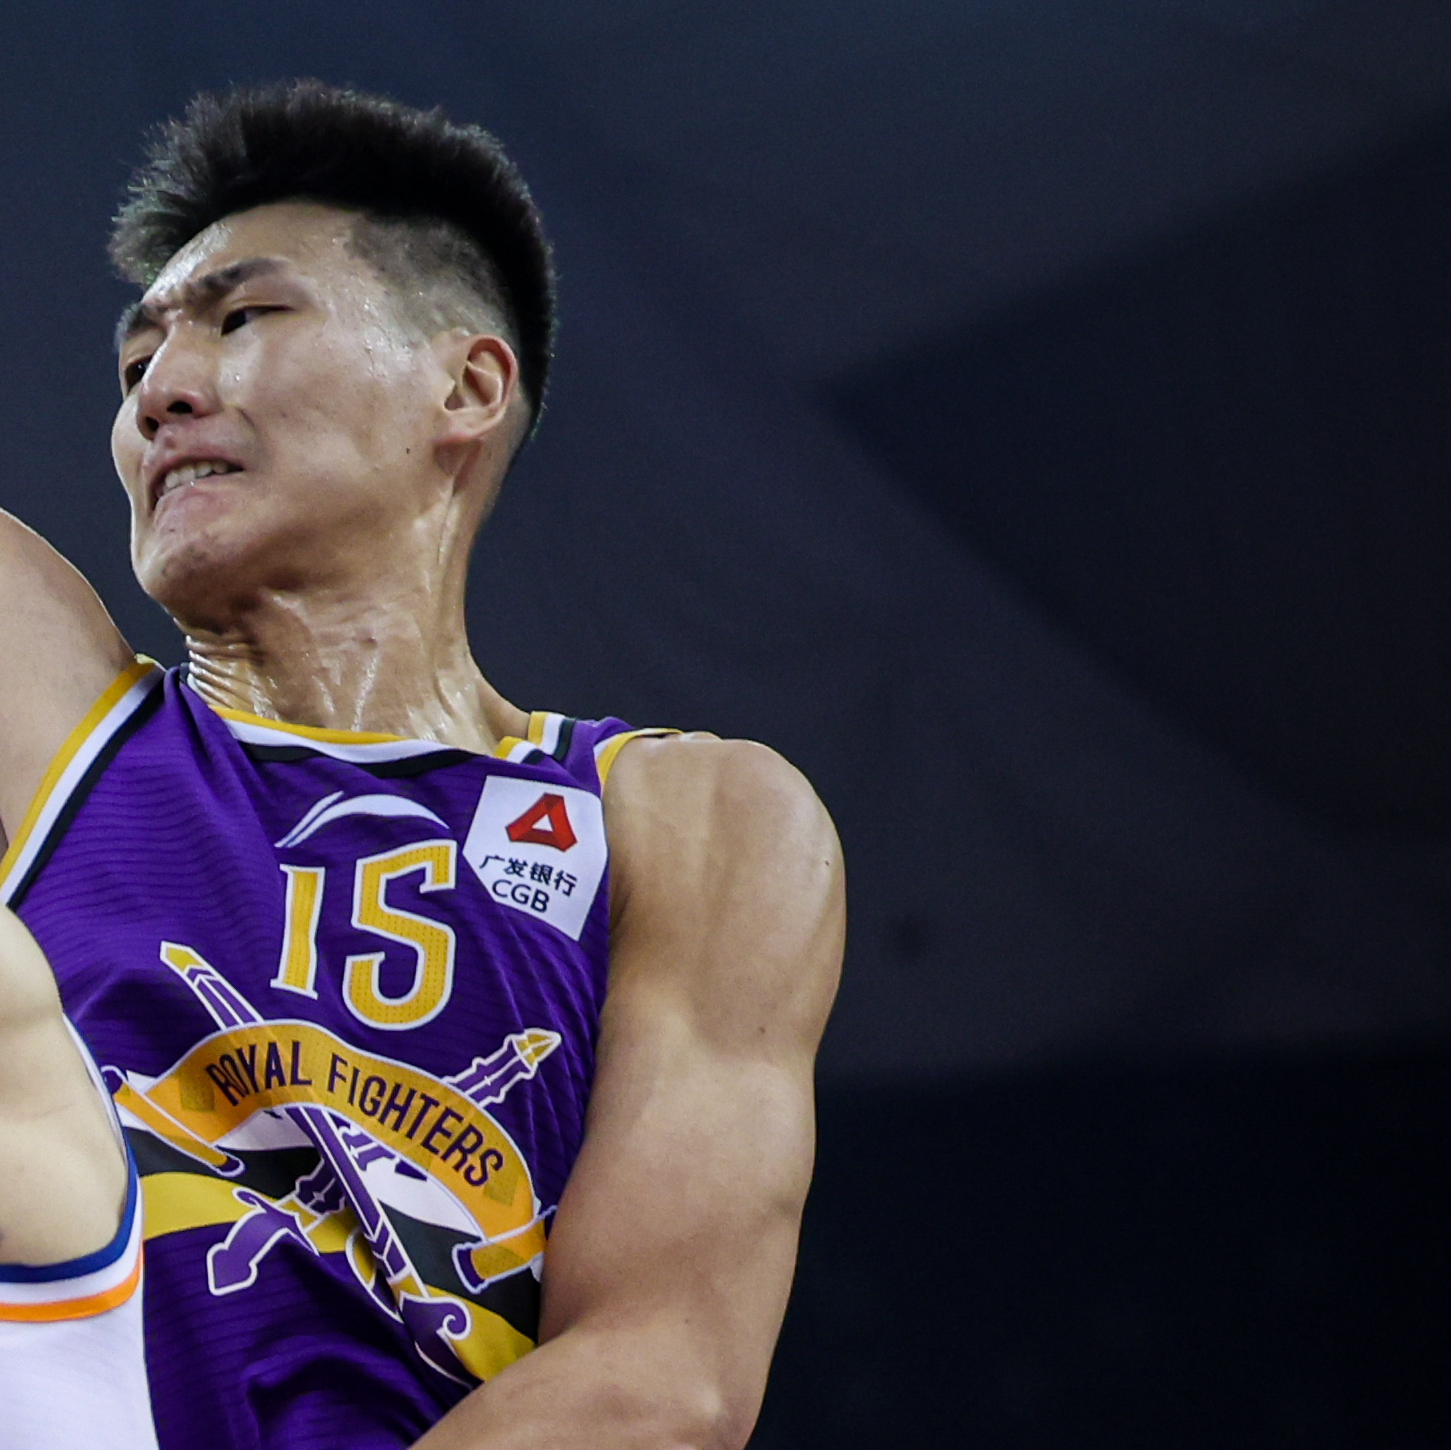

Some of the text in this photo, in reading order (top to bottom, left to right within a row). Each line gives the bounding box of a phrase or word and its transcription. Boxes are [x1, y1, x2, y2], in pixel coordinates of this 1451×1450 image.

[479, 854, 578, 897] 广发银行
[492, 879, 550, 913] CGB
[272, 840, 457, 1030] 15
[205, 1040, 504, 1187] ROYAL FIGHTERS
